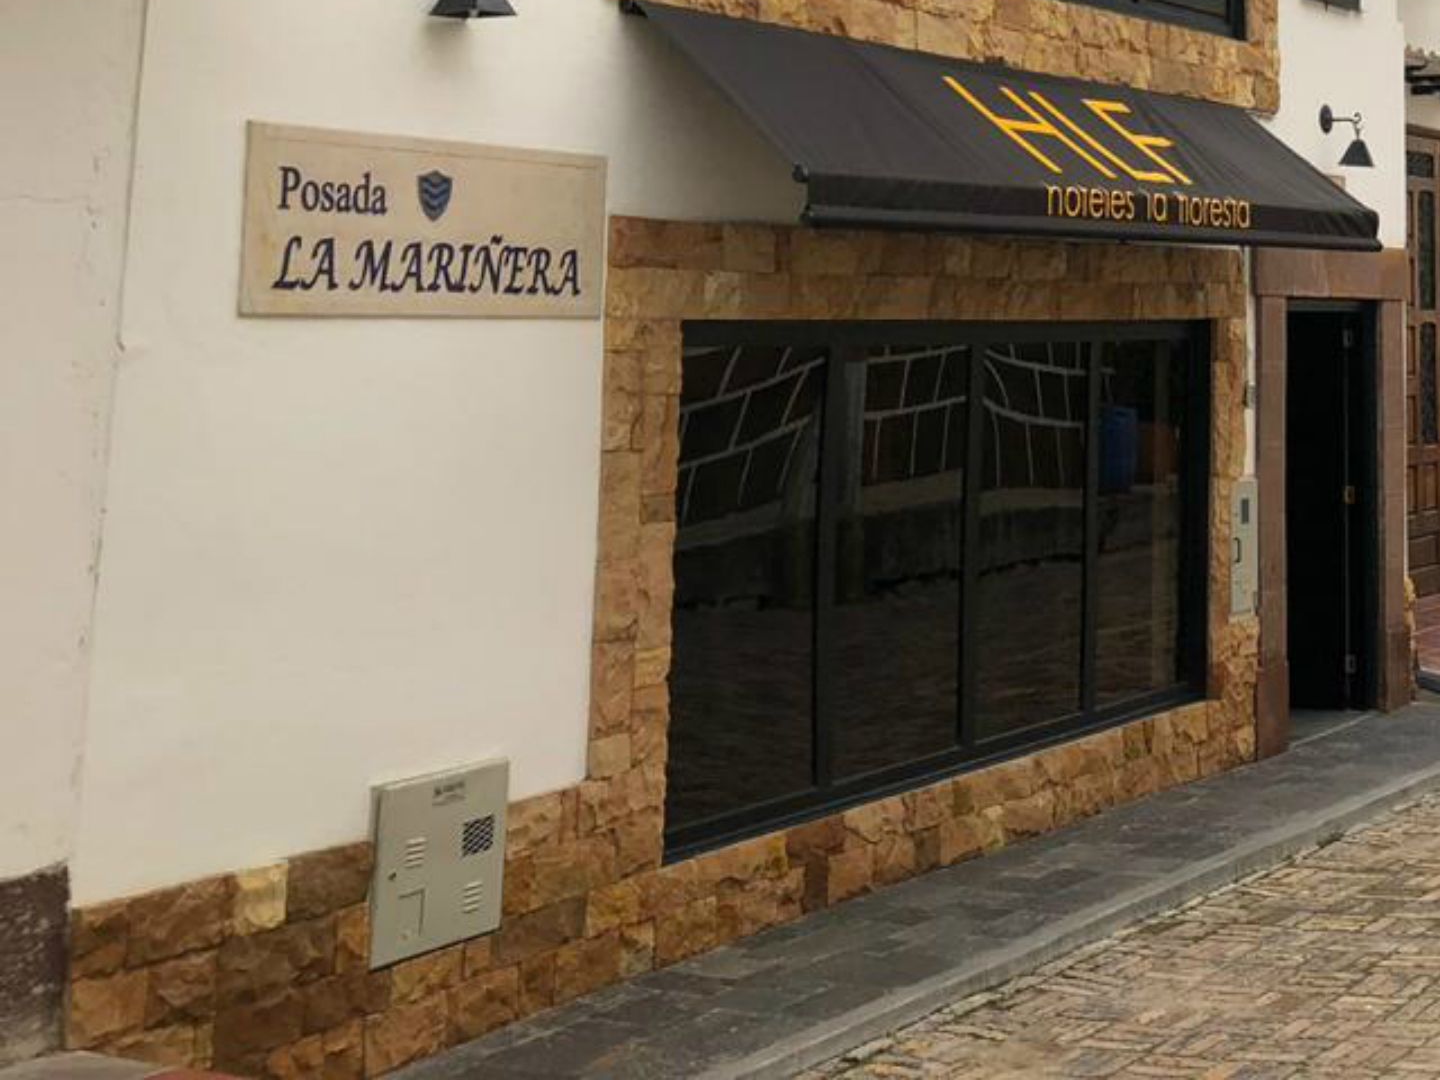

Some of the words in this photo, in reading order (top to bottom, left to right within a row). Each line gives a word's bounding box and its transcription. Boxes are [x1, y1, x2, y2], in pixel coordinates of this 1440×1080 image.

[277, 166, 387, 214] Posada
[272, 235, 339, 291] LA
[350, 234, 581, 296] MARIÑERA
